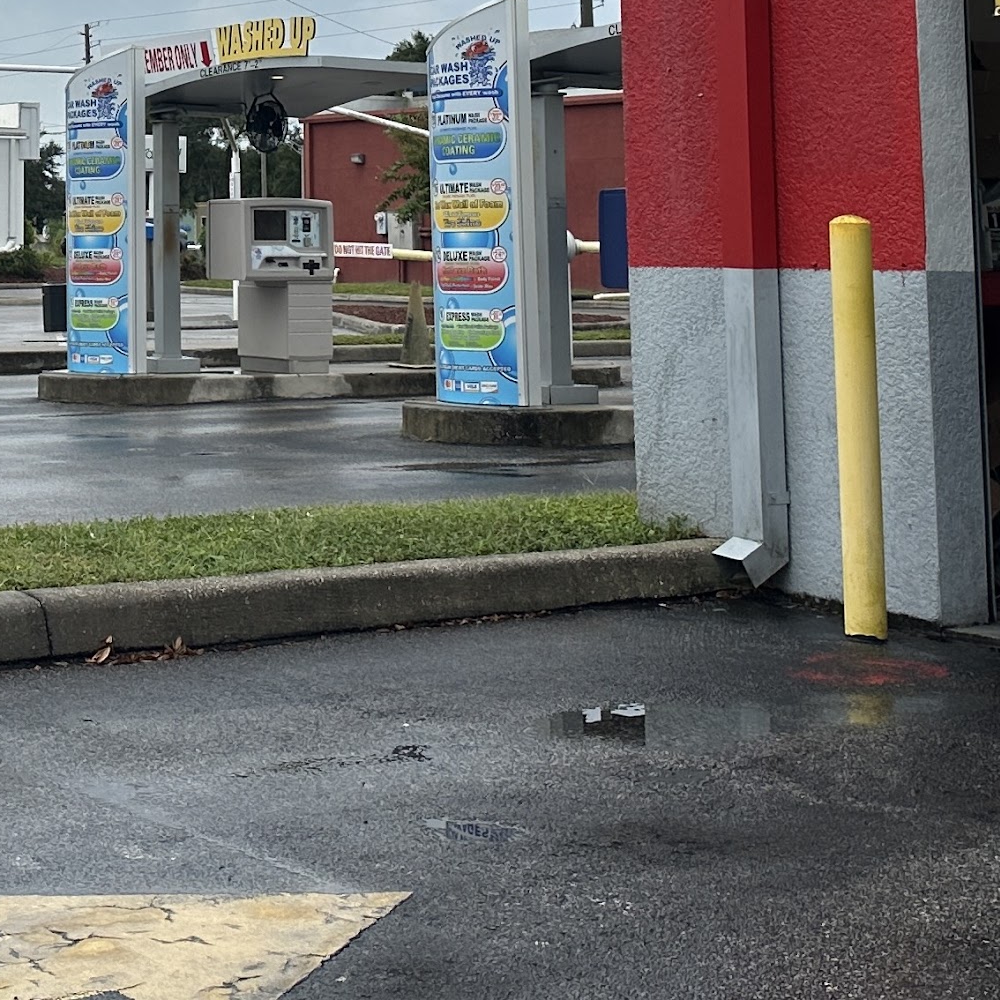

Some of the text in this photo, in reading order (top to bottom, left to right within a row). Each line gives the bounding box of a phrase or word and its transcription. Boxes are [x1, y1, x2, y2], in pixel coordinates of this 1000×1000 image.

[216, 16, 317, 57] WASHED UP
[455, 34, 501, 50] WASHED UP
[144, 42, 198, 74] EMBER ONLY
[200, 61, 241, 78] CLEARANCE
[441, 61, 468, 73] WASH
[75, 99, 97, 108] WASH
[68, 109, 98, 119] ACKAGES
[437, 112, 467, 126] PLATINUM
[442, 145, 476, 156] COATING
[439, 182, 469, 195] ULTIMATE
[365, 245, 375, 256] THE
[375, 246, 391, 256] GATE
[443, 250, 468, 261] DELUXE
[446, 311, 471, 322] EXPRESS
